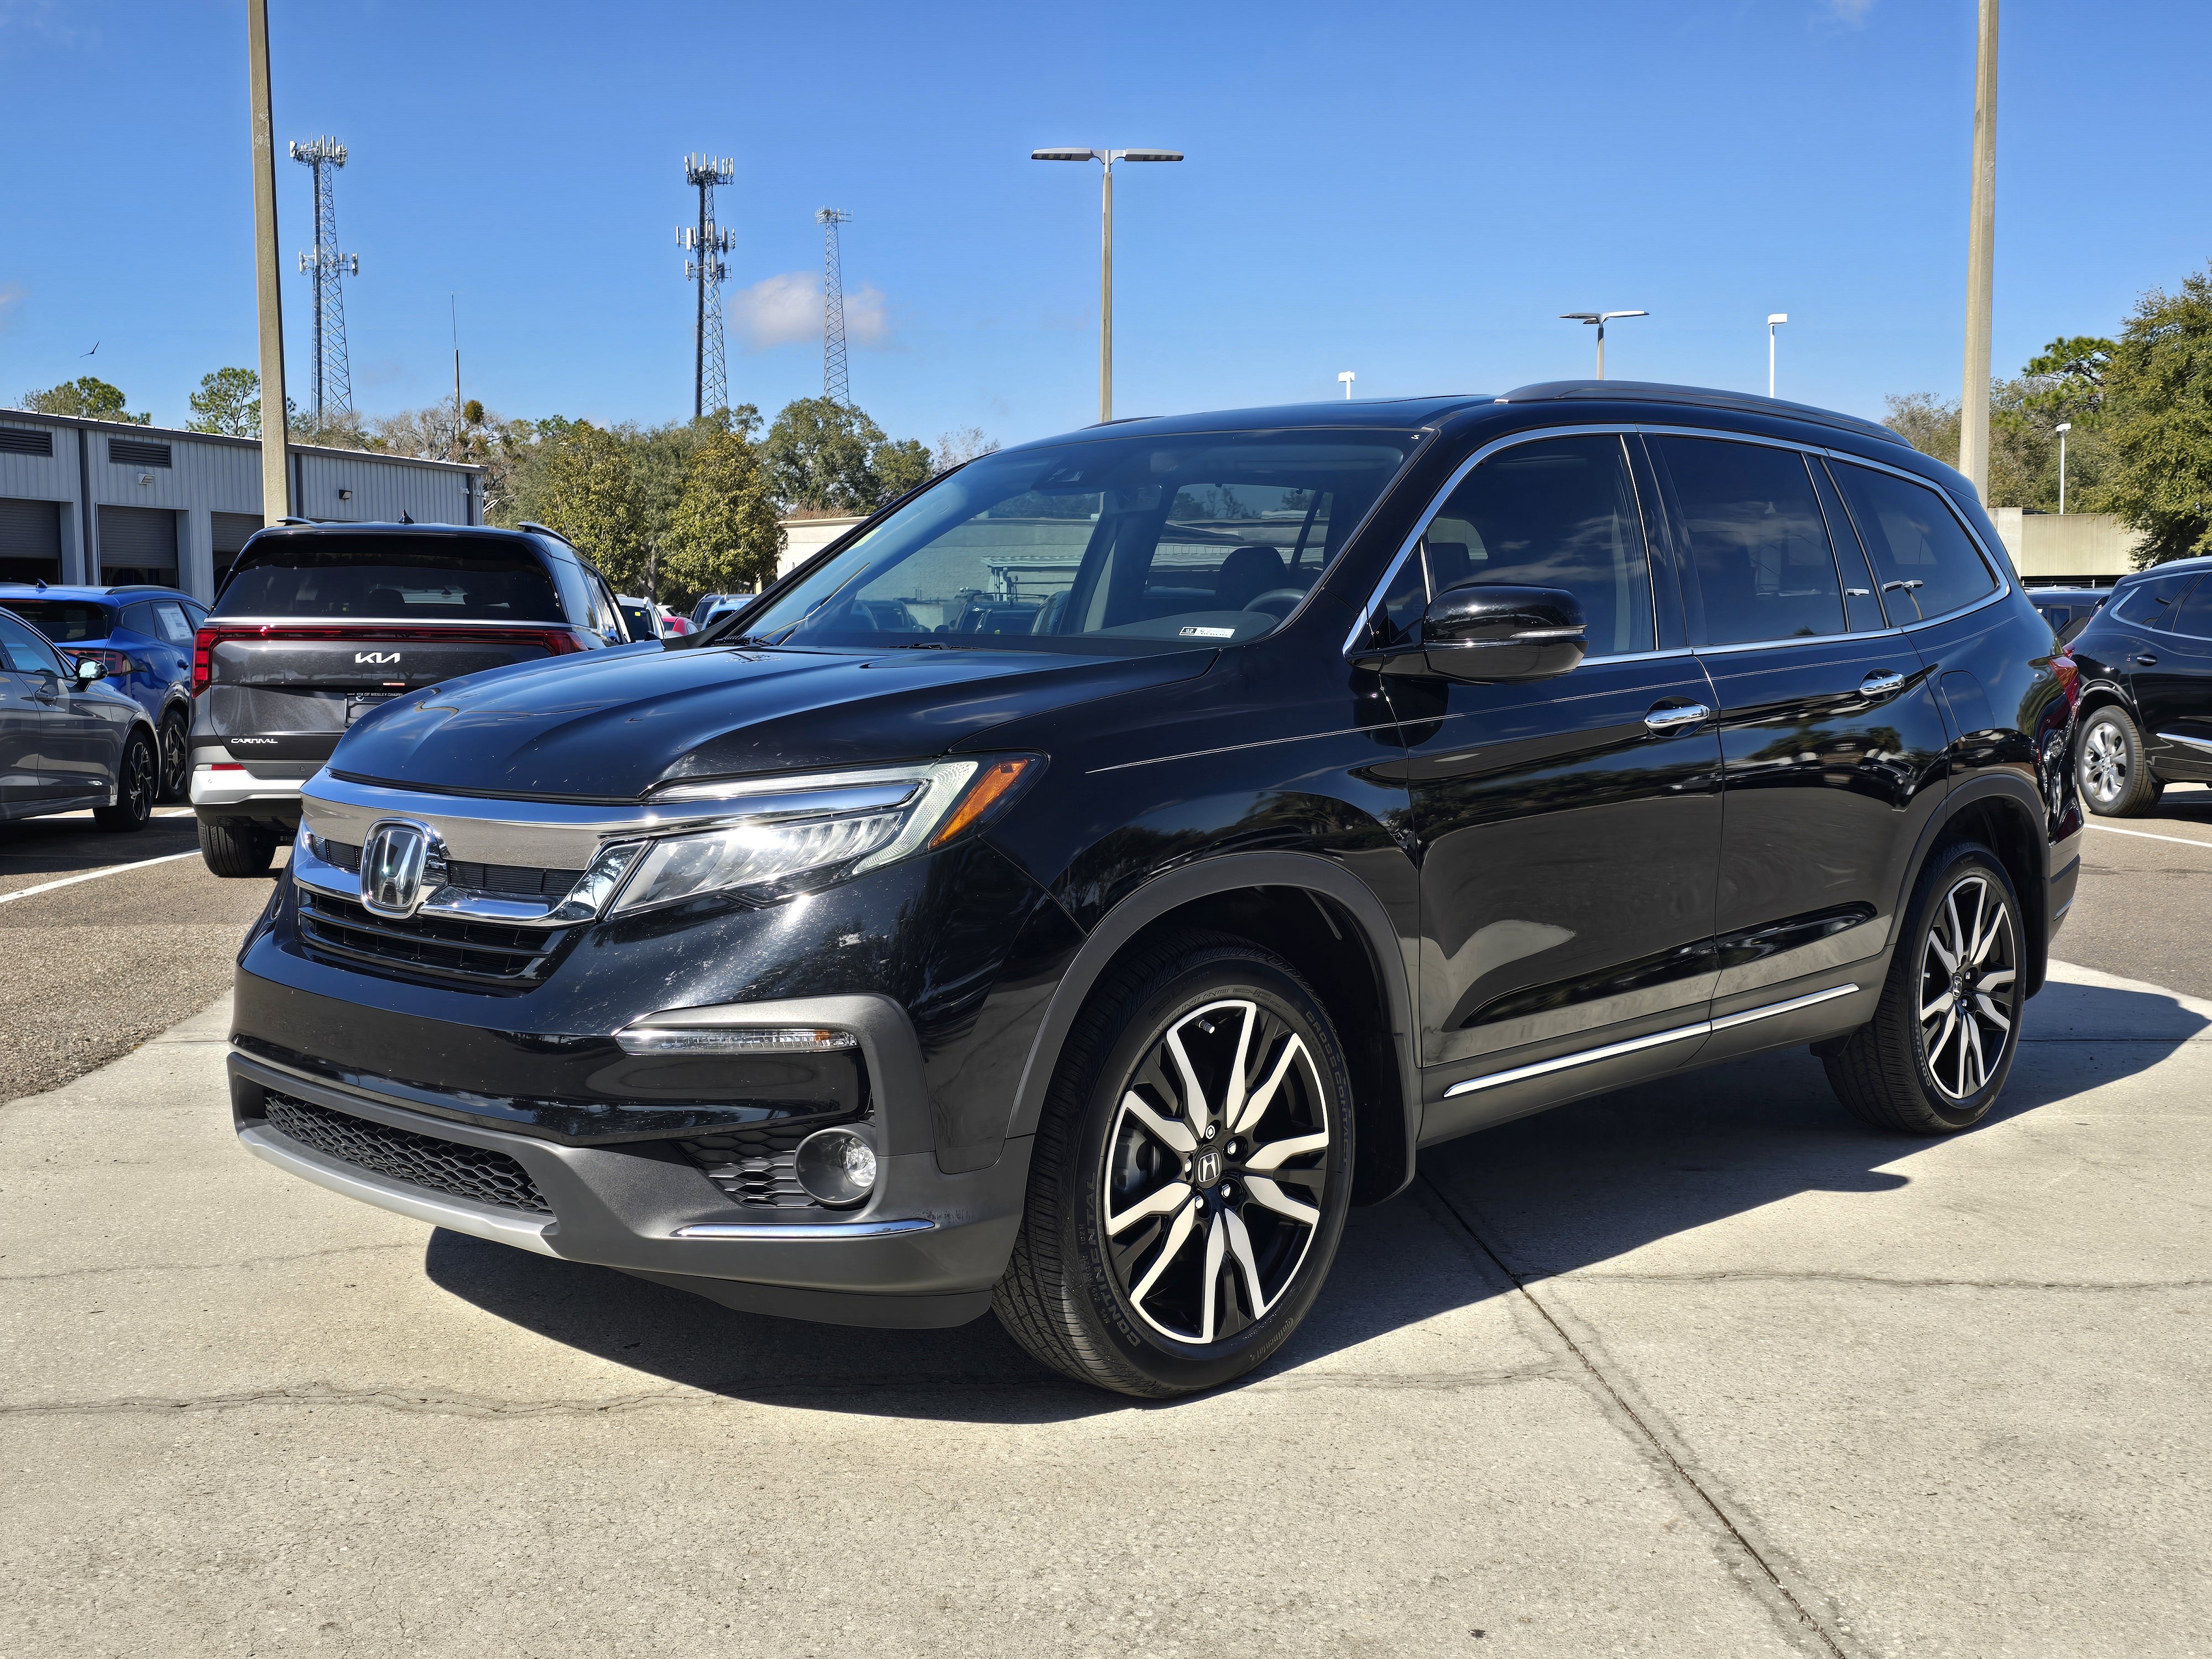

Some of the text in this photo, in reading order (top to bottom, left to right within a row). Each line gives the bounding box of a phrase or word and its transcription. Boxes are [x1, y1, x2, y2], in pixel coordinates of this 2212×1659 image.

[355, 652, 400, 664] KIA
[1306, 1011, 1337, 1068] CROSS
[1334, 1071, 1348, 1167] CONTACT
[1087, 1172, 1141, 1347] CONTINENTAL
